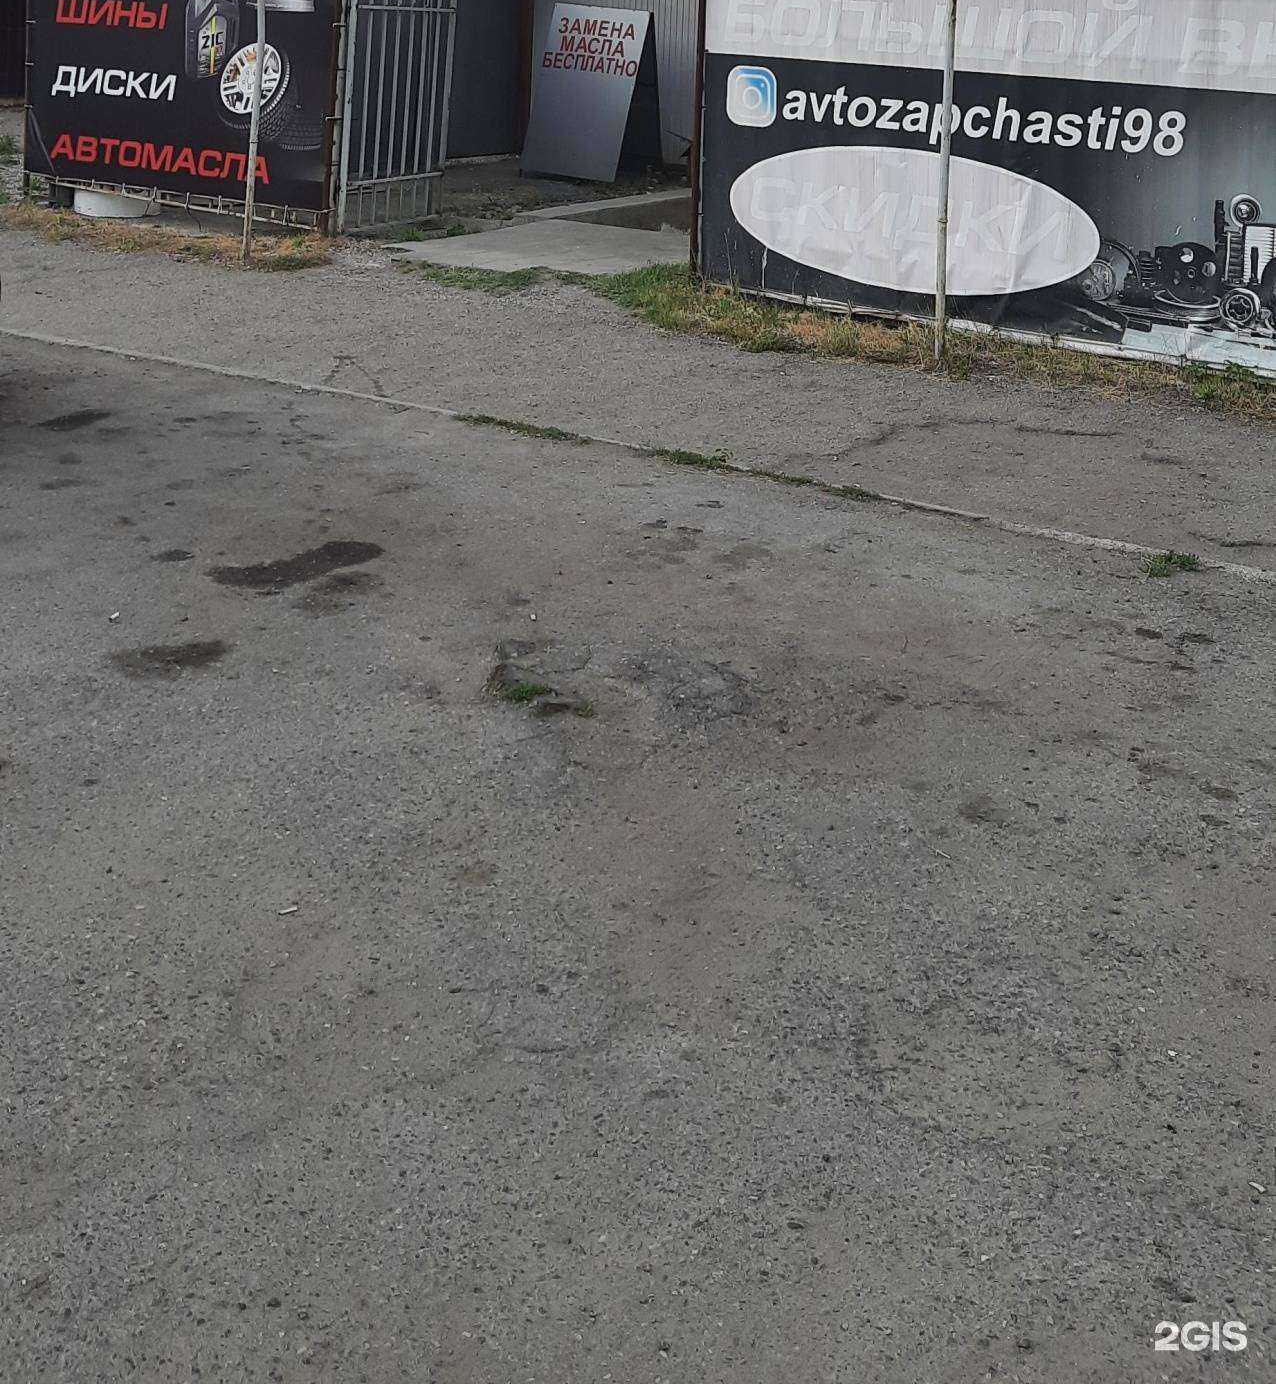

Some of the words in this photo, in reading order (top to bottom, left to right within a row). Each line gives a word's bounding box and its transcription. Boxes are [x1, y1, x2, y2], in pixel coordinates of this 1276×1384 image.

[201, 32, 223, 49] ZIC
[559, 17, 635, 40] ЗАМЕНА
[560, 35, 625, 57] МАСЛА
[543, 51, 638, 77] БЕСПЛАТНО
[51, 65, 177, 101] ДИСКИ
[782, 86, 1187, 157] avtozapchasti98
[50, 134, 270, 184] АВТОМАСЛА
